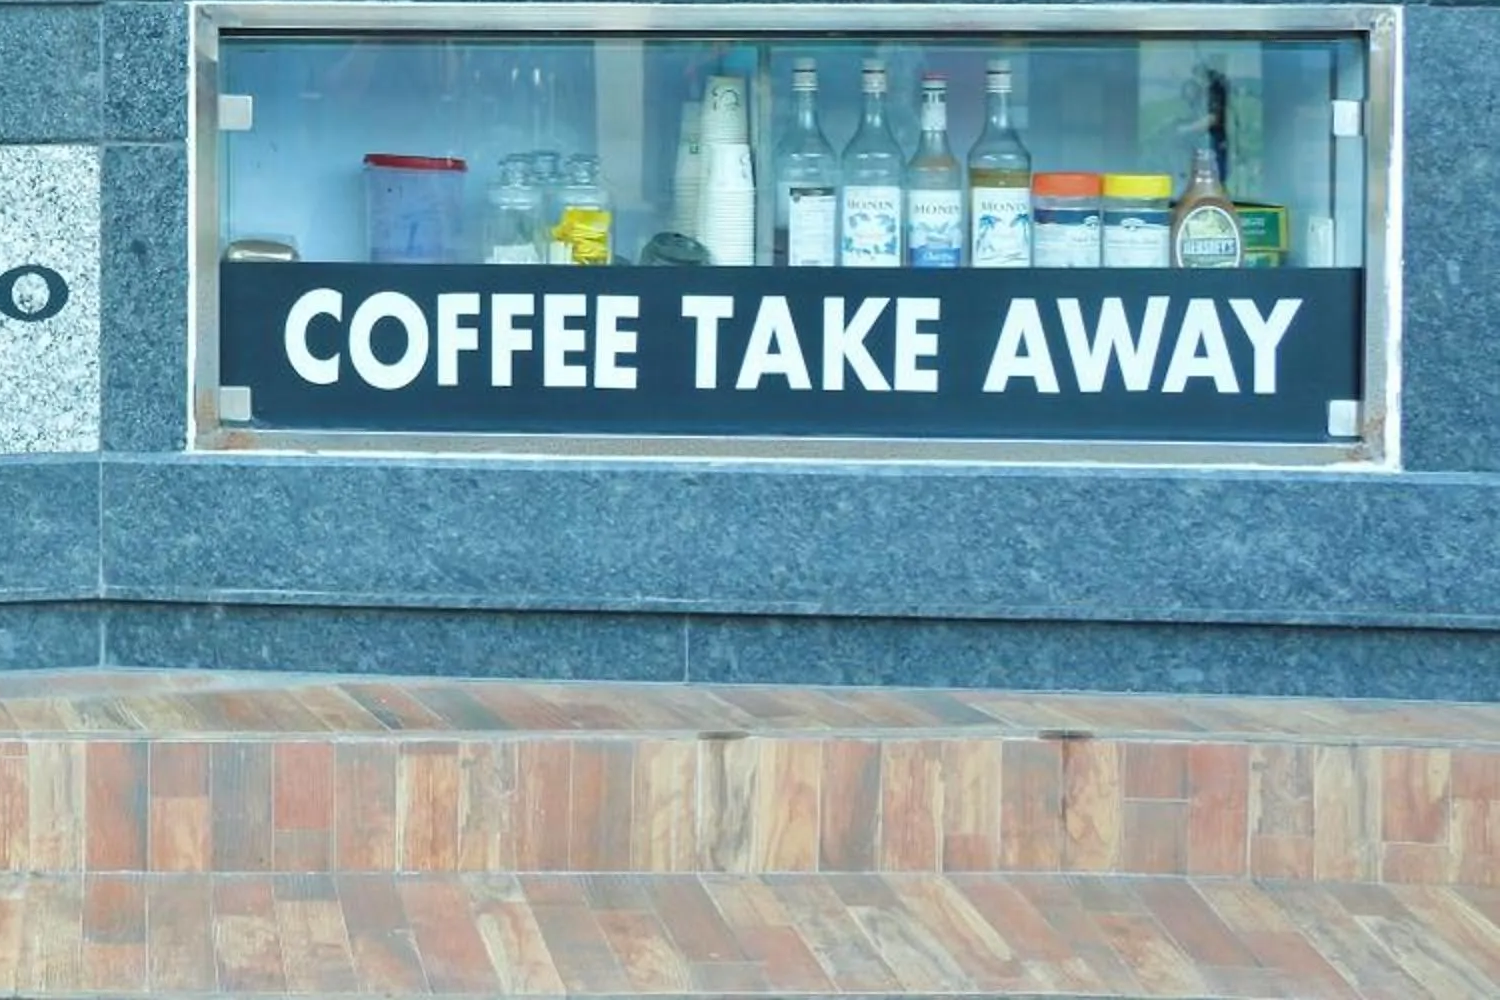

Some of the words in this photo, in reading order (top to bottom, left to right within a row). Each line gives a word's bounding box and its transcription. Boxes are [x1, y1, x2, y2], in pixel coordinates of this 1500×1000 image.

[285, 288, 639, 389] COFFEE
[682, 296, 940, 392] TAKE
[983, 296, 1302, 393] AWAY
